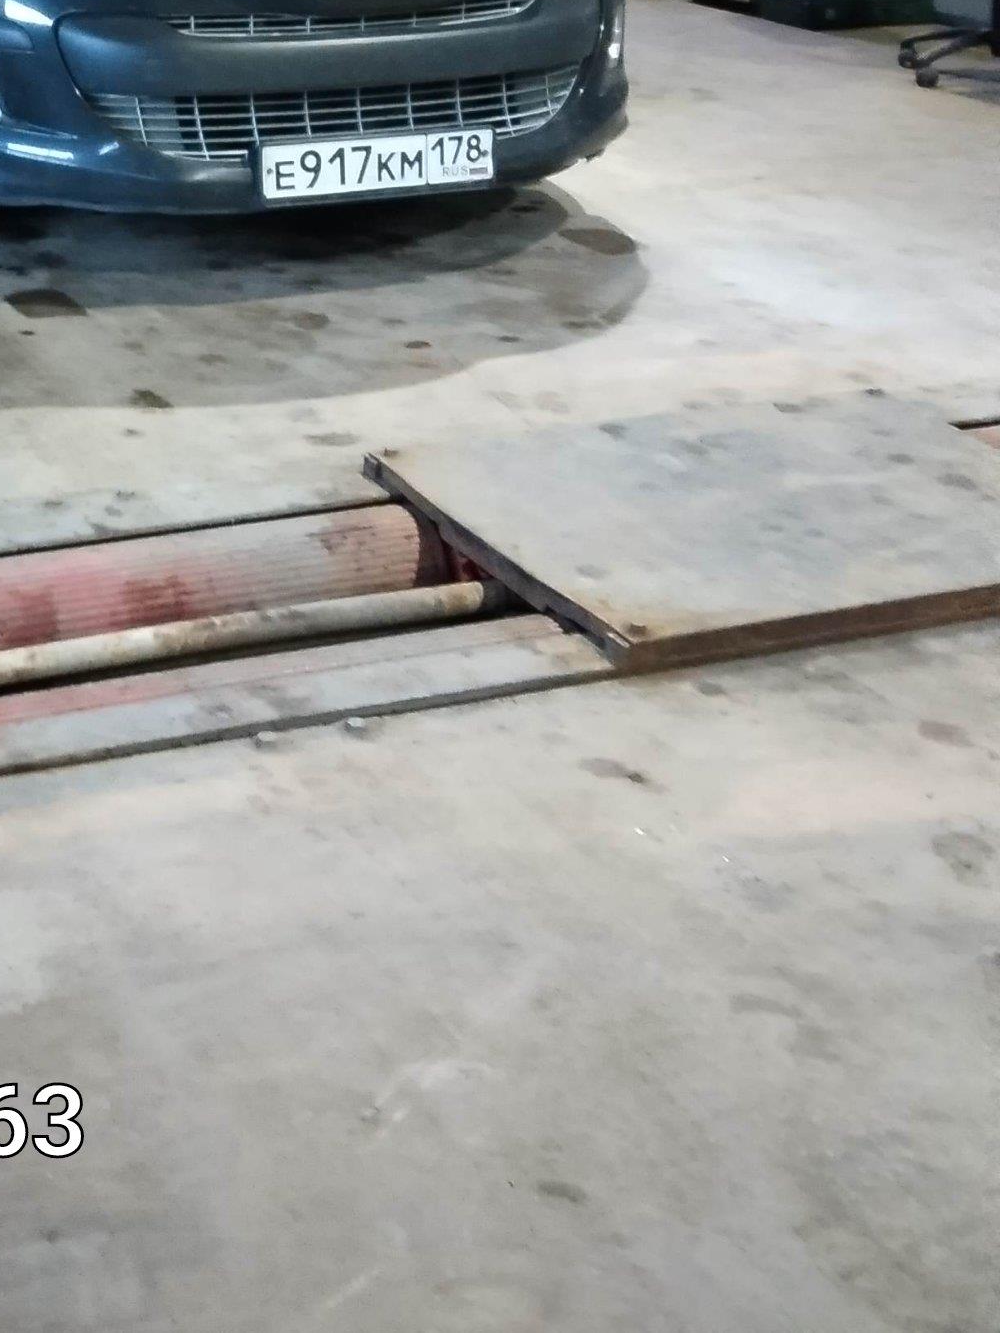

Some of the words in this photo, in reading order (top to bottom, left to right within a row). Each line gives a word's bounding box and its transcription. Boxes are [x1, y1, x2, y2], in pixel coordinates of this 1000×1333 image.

[275, 145, 423, 191] E917KM
[430, 134, 482, 166] 178
[442, 165, 469, 178] RUS
